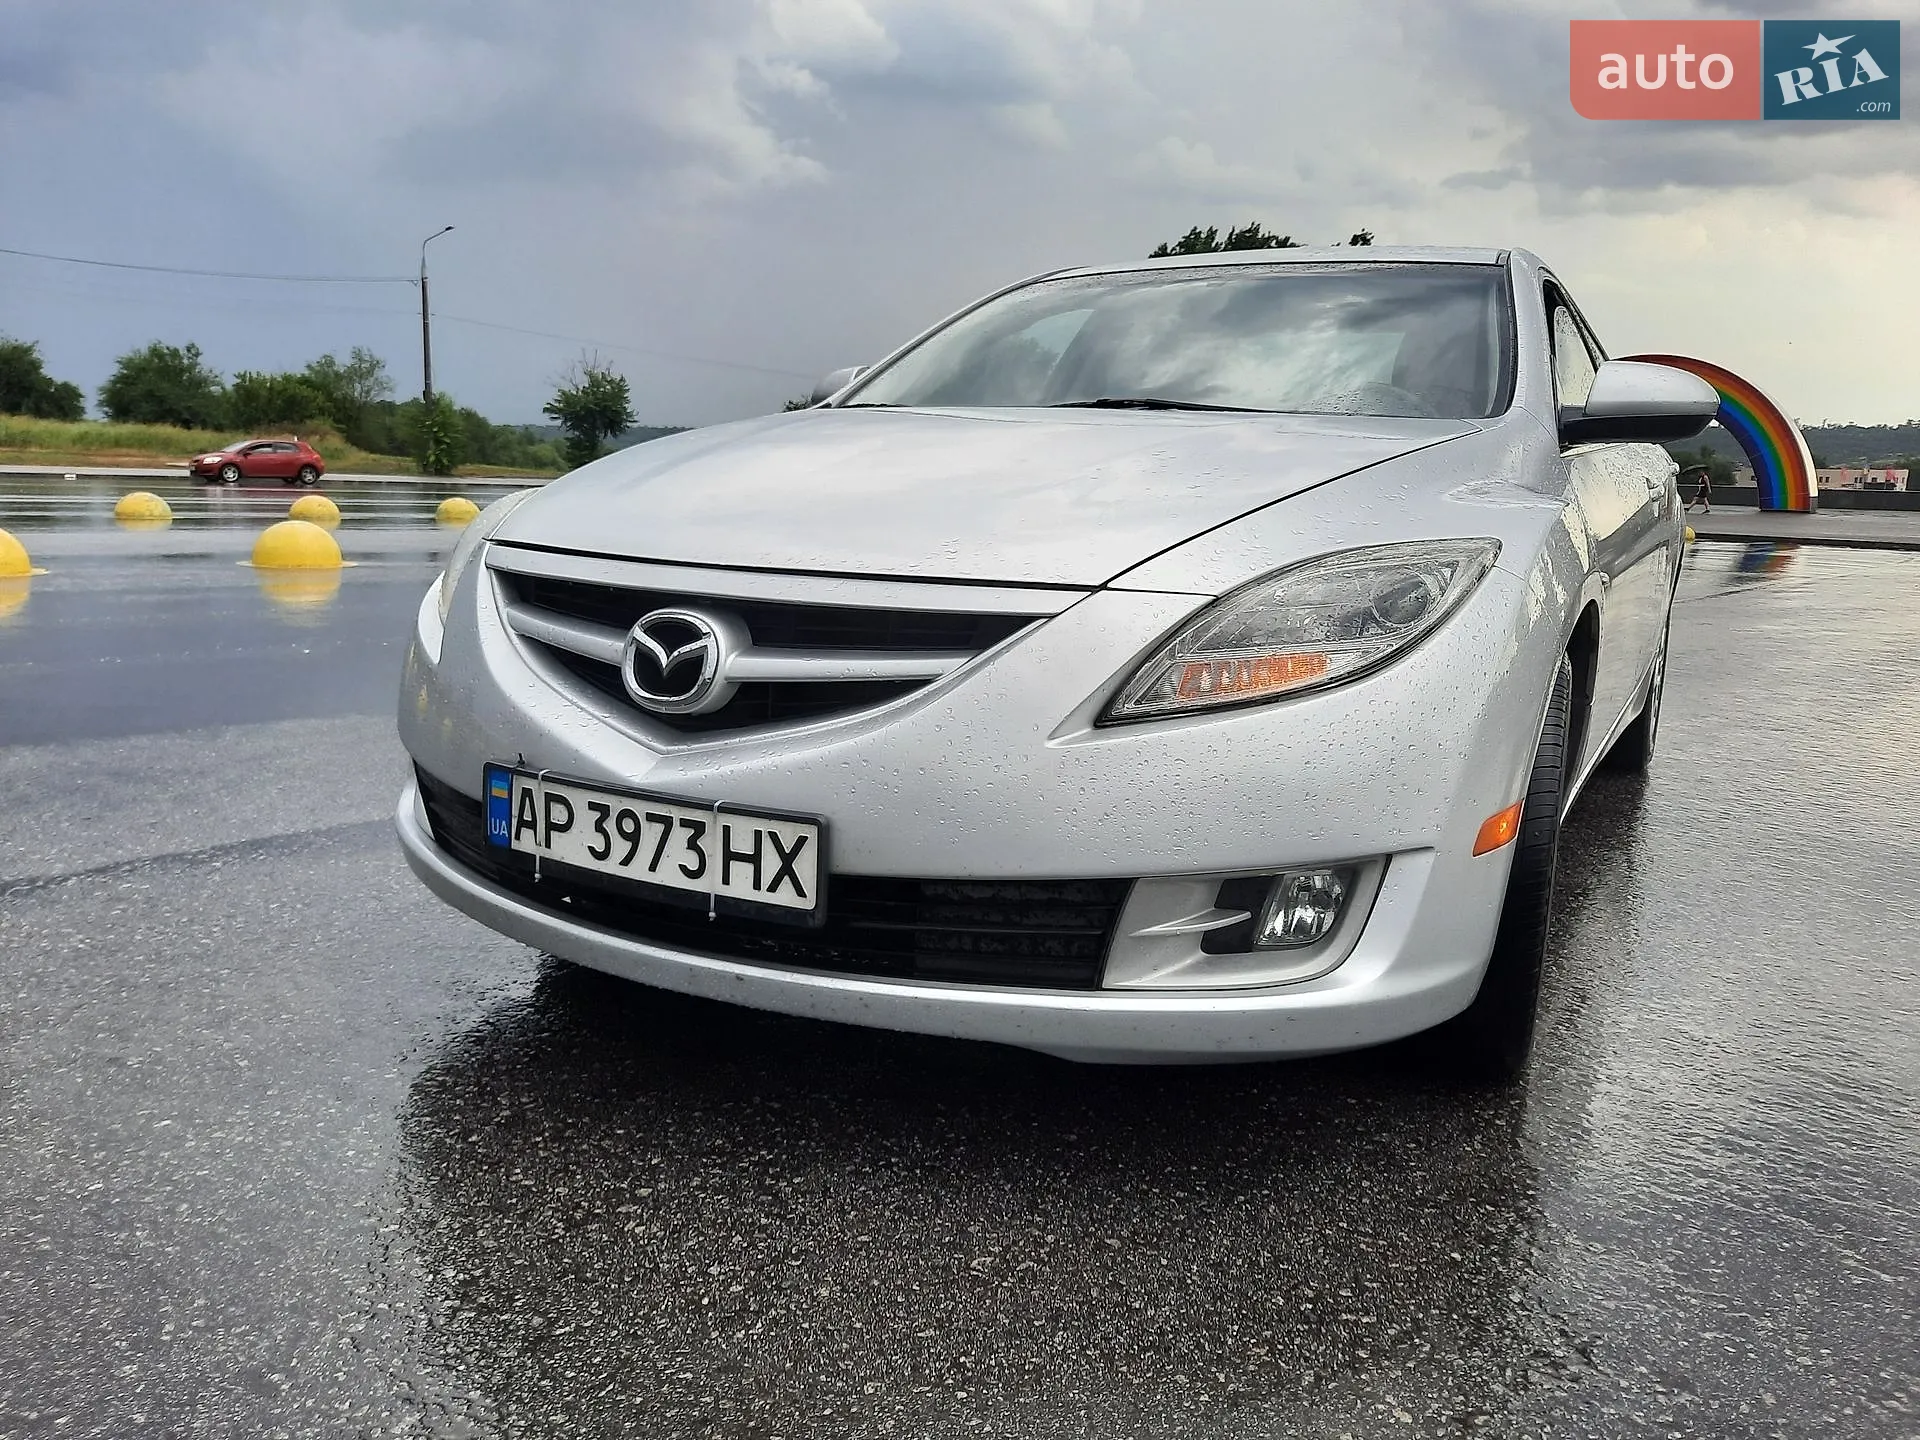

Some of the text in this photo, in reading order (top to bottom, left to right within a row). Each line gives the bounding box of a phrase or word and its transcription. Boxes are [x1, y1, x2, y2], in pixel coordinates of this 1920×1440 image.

[492, 818, 509, 838] UA
[514, 786, 809, 899] AP 3973 HX
